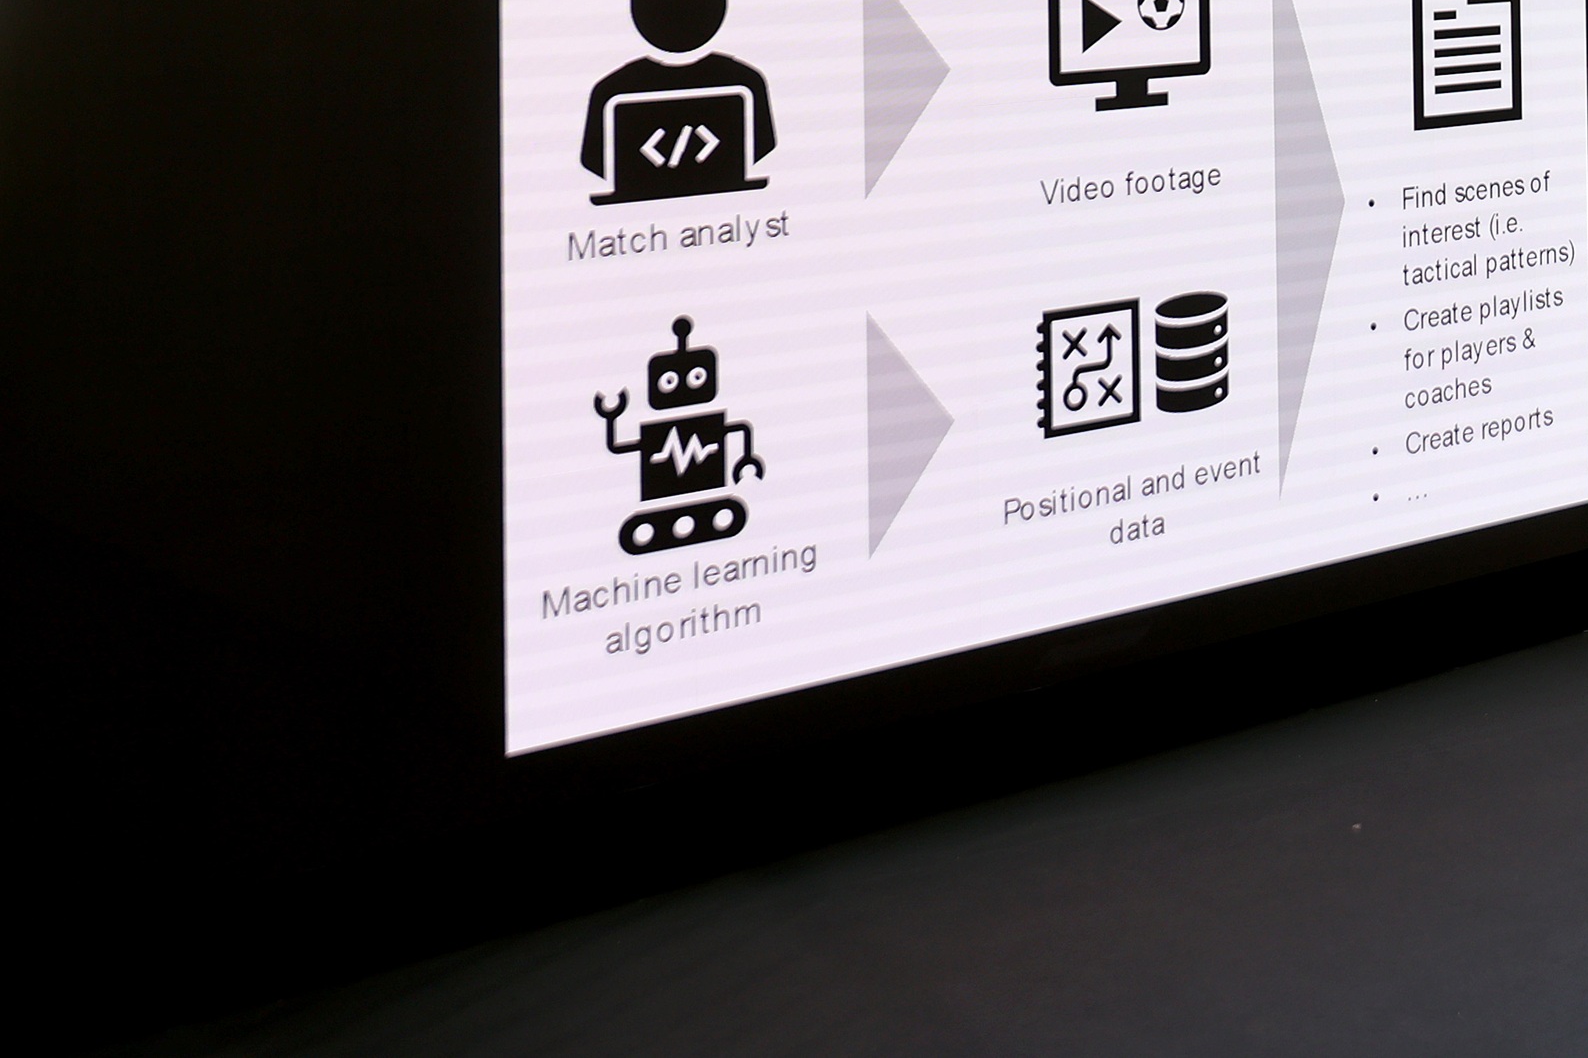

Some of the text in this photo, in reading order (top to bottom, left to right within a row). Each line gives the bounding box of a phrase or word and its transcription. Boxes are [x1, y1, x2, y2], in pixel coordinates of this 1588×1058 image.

[1040, 168, 1221, 204] Video footage
[1403, 170, 1550, 210] Find scenes of
[569, 211, 789, 261] Match analyst
[1403, 213, 1522, 248] interest (i.e.
[1403, 240, 1574, 286] tactical patterns)
[1404, 288, 1563, 331] Create playlists
[1404, 328, 1535, 371] for players &
[1405, 378, 1492, 409] coaches
[1406, 408, 1553, 454] Create reports
[1004, 451, 1260, 525] Positional and event
[1110, 515, 1165, 544] data
[542, 545, 816, 619] Machine learning
[605, 597, 761, 655] algorithm
